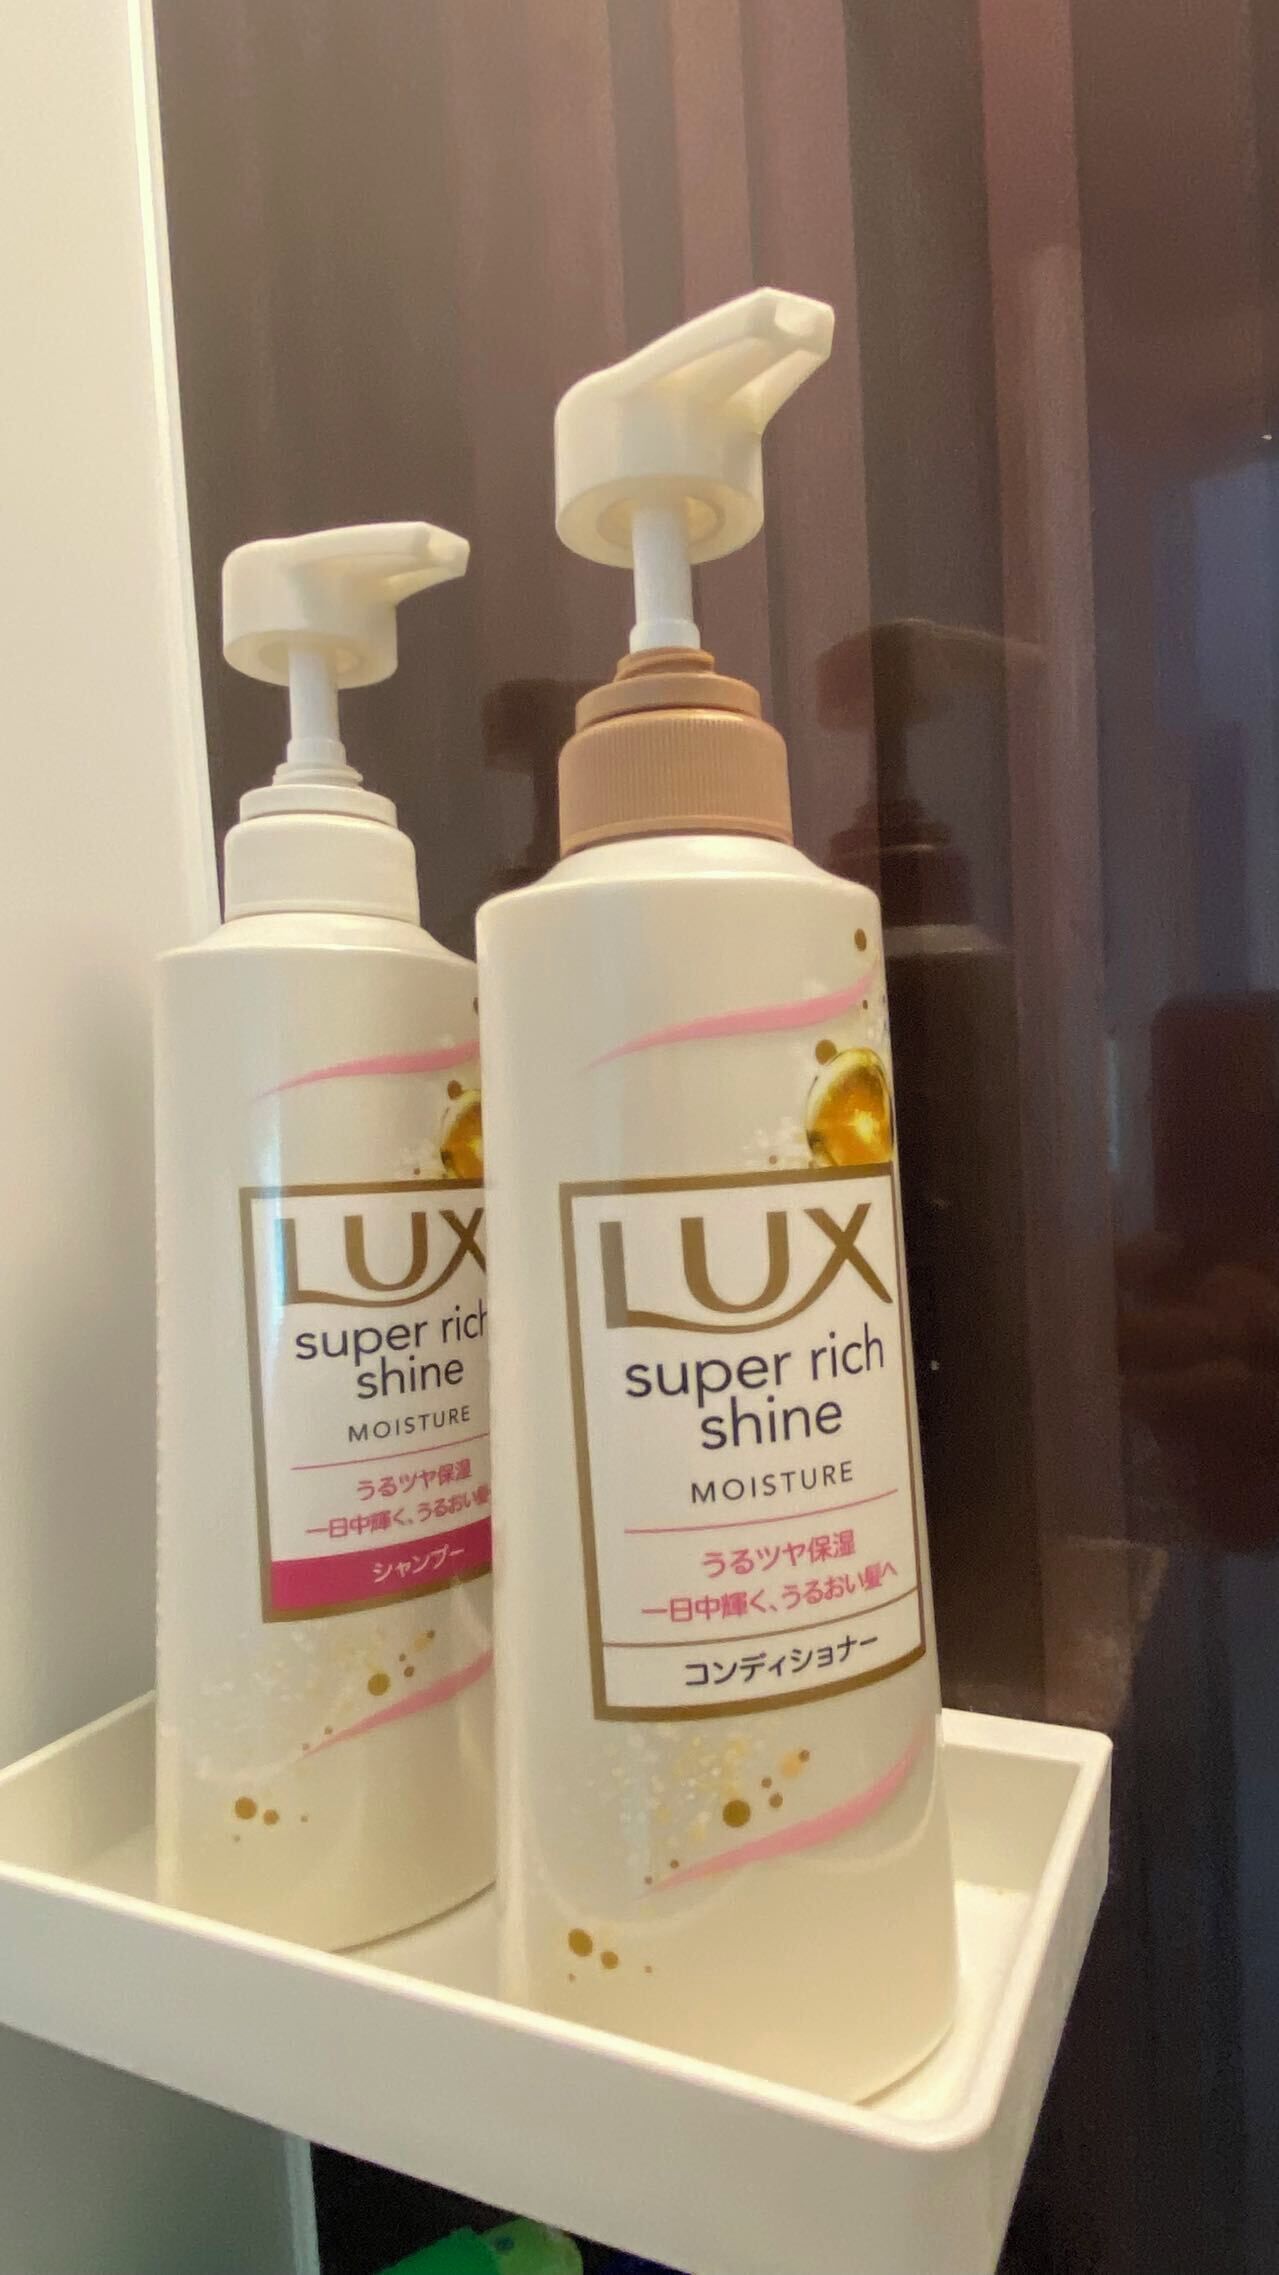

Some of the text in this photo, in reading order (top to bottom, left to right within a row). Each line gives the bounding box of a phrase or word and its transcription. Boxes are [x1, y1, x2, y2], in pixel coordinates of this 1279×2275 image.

[274, 1207, 487, 1308] LUX
[600, 1202, 893, 1334] LUX
[295, 1319, 428, 1367] super
[625, 1322, 885, 1409] super rich
[356, 1355, 465, 1400] shine
[348, 1405, 472, 1442] MOISTURE
[700, 1395, 843, 1450] shine
[356, 1458, 473, 1501] うるツヤ保湿
[690, 1460, 854, 1504] MOISTURE
[372, 1544, 465, 1583] シャンプー
[702, 1529, 856, 1578] うるツヤ保湿
[685, 1635, 879, 1687] コンディショナー
